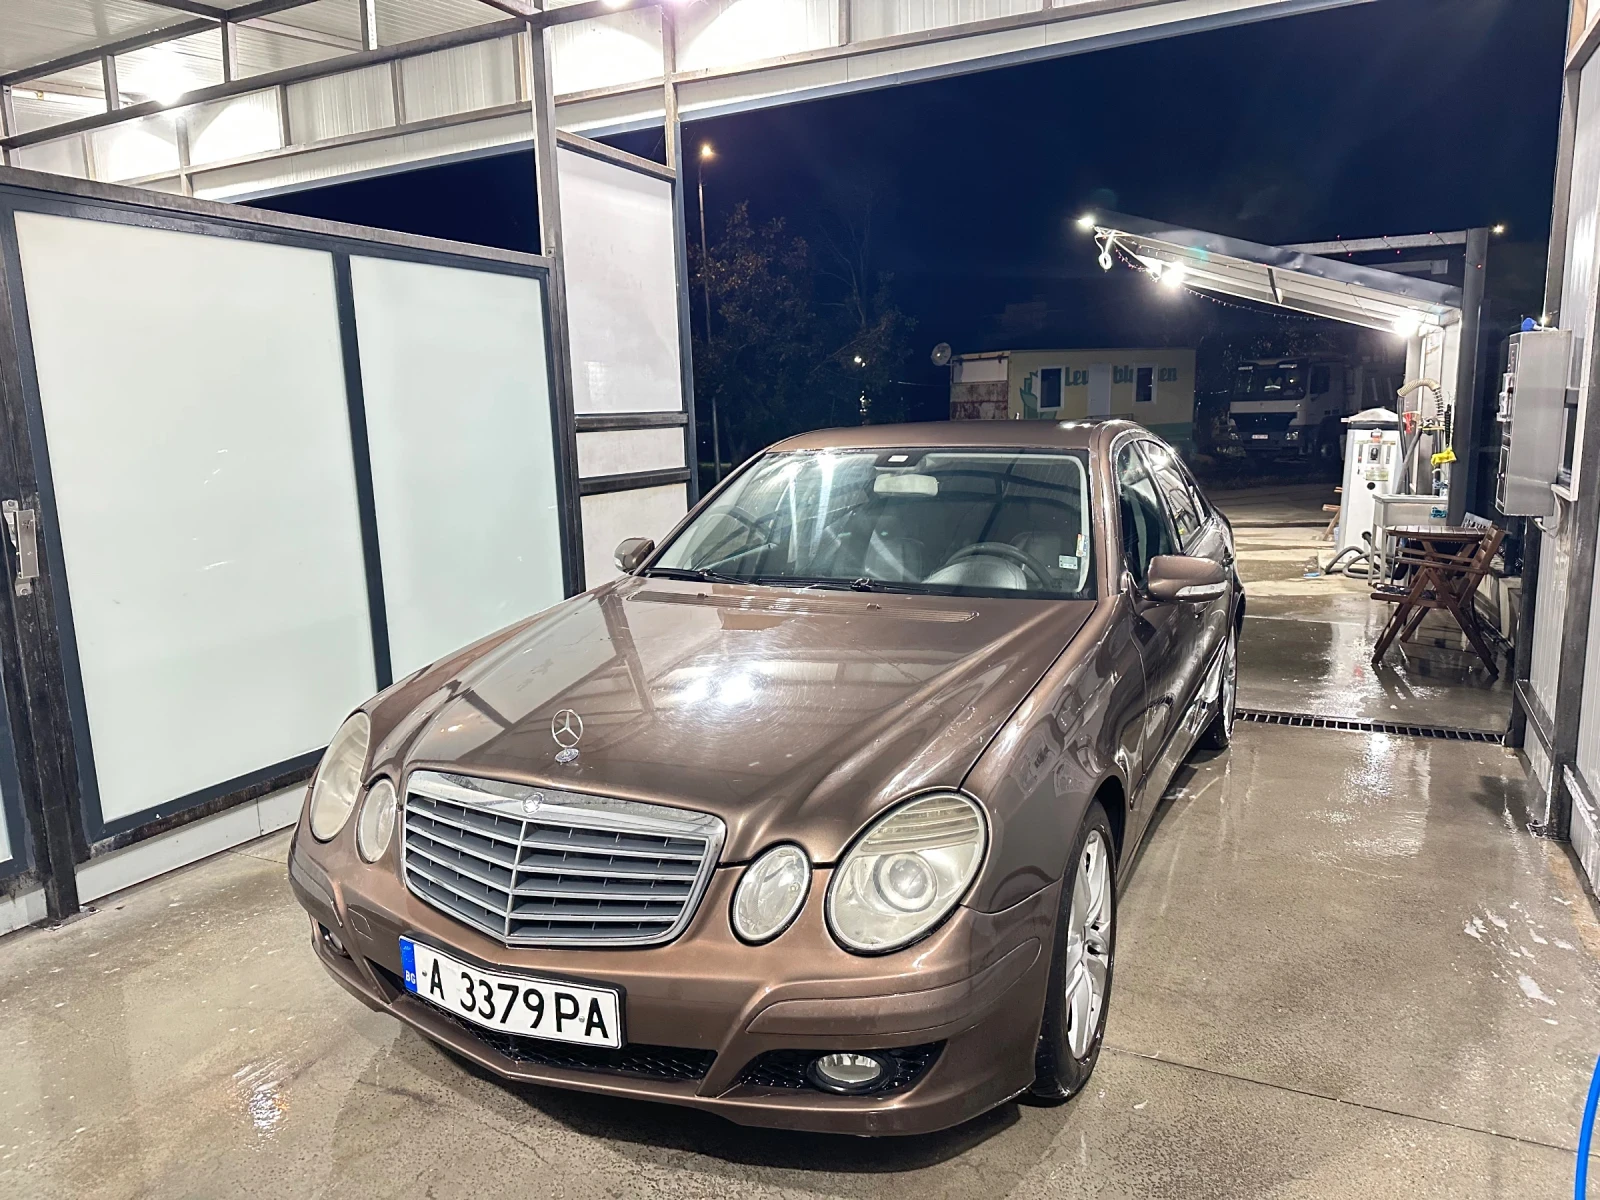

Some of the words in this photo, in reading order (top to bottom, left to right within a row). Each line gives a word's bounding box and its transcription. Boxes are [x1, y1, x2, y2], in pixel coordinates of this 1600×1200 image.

[405, 970, 416, 984] BG
[430, 958, 445, 1000] A
[460, 971, 545, 1029] 3379
[555, 991, 609, 1039] PA
